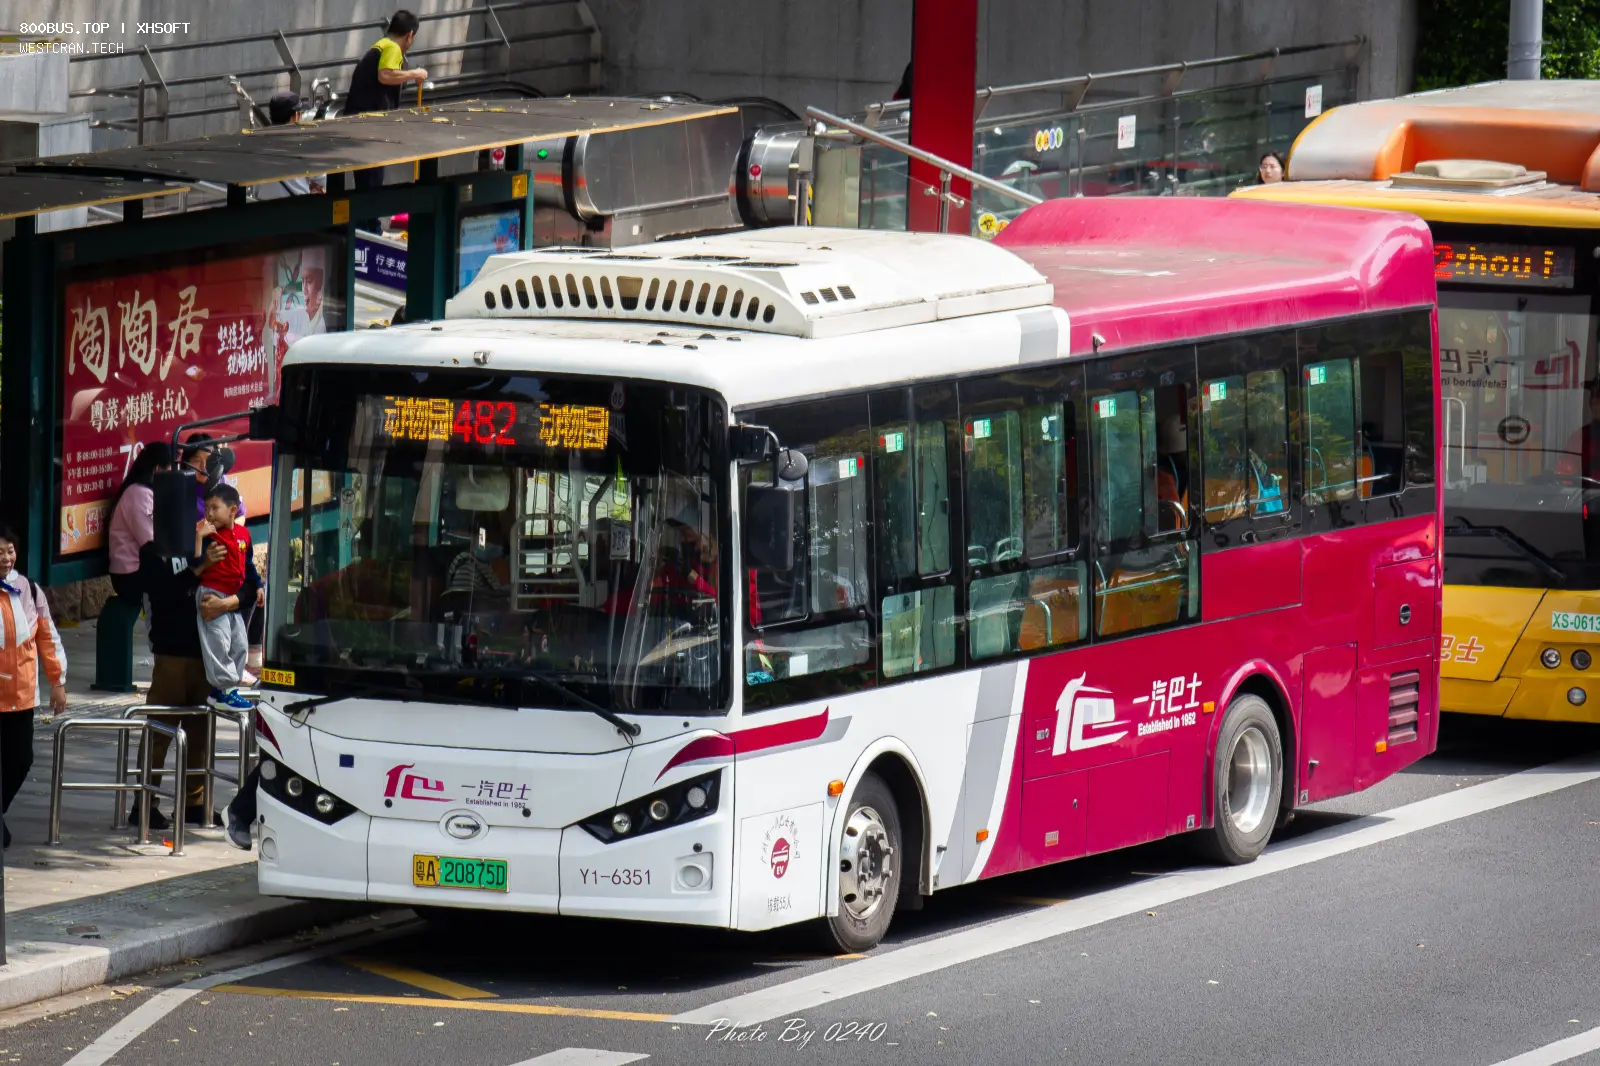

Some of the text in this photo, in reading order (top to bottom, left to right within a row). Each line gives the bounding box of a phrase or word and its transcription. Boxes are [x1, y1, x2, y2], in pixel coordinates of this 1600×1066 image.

[69, 285, 209, 384] 陶陶居
[384, 395, 610, 450] 动物园 482 动物园
[1133, 672, 1202, 717] 一汽巴士
[1137, 712, 1196, 736] Established in 1952
[461, 780, 532, 800] 一汽巴士
[465, 797, 502, 807] Established
[511, 801, 526, 809] 1952
[415, 860, 506, 886] 粤A 20875D
[579, 868, 651, 886] Y1-6351
[776, 865, 785, 875] EV
